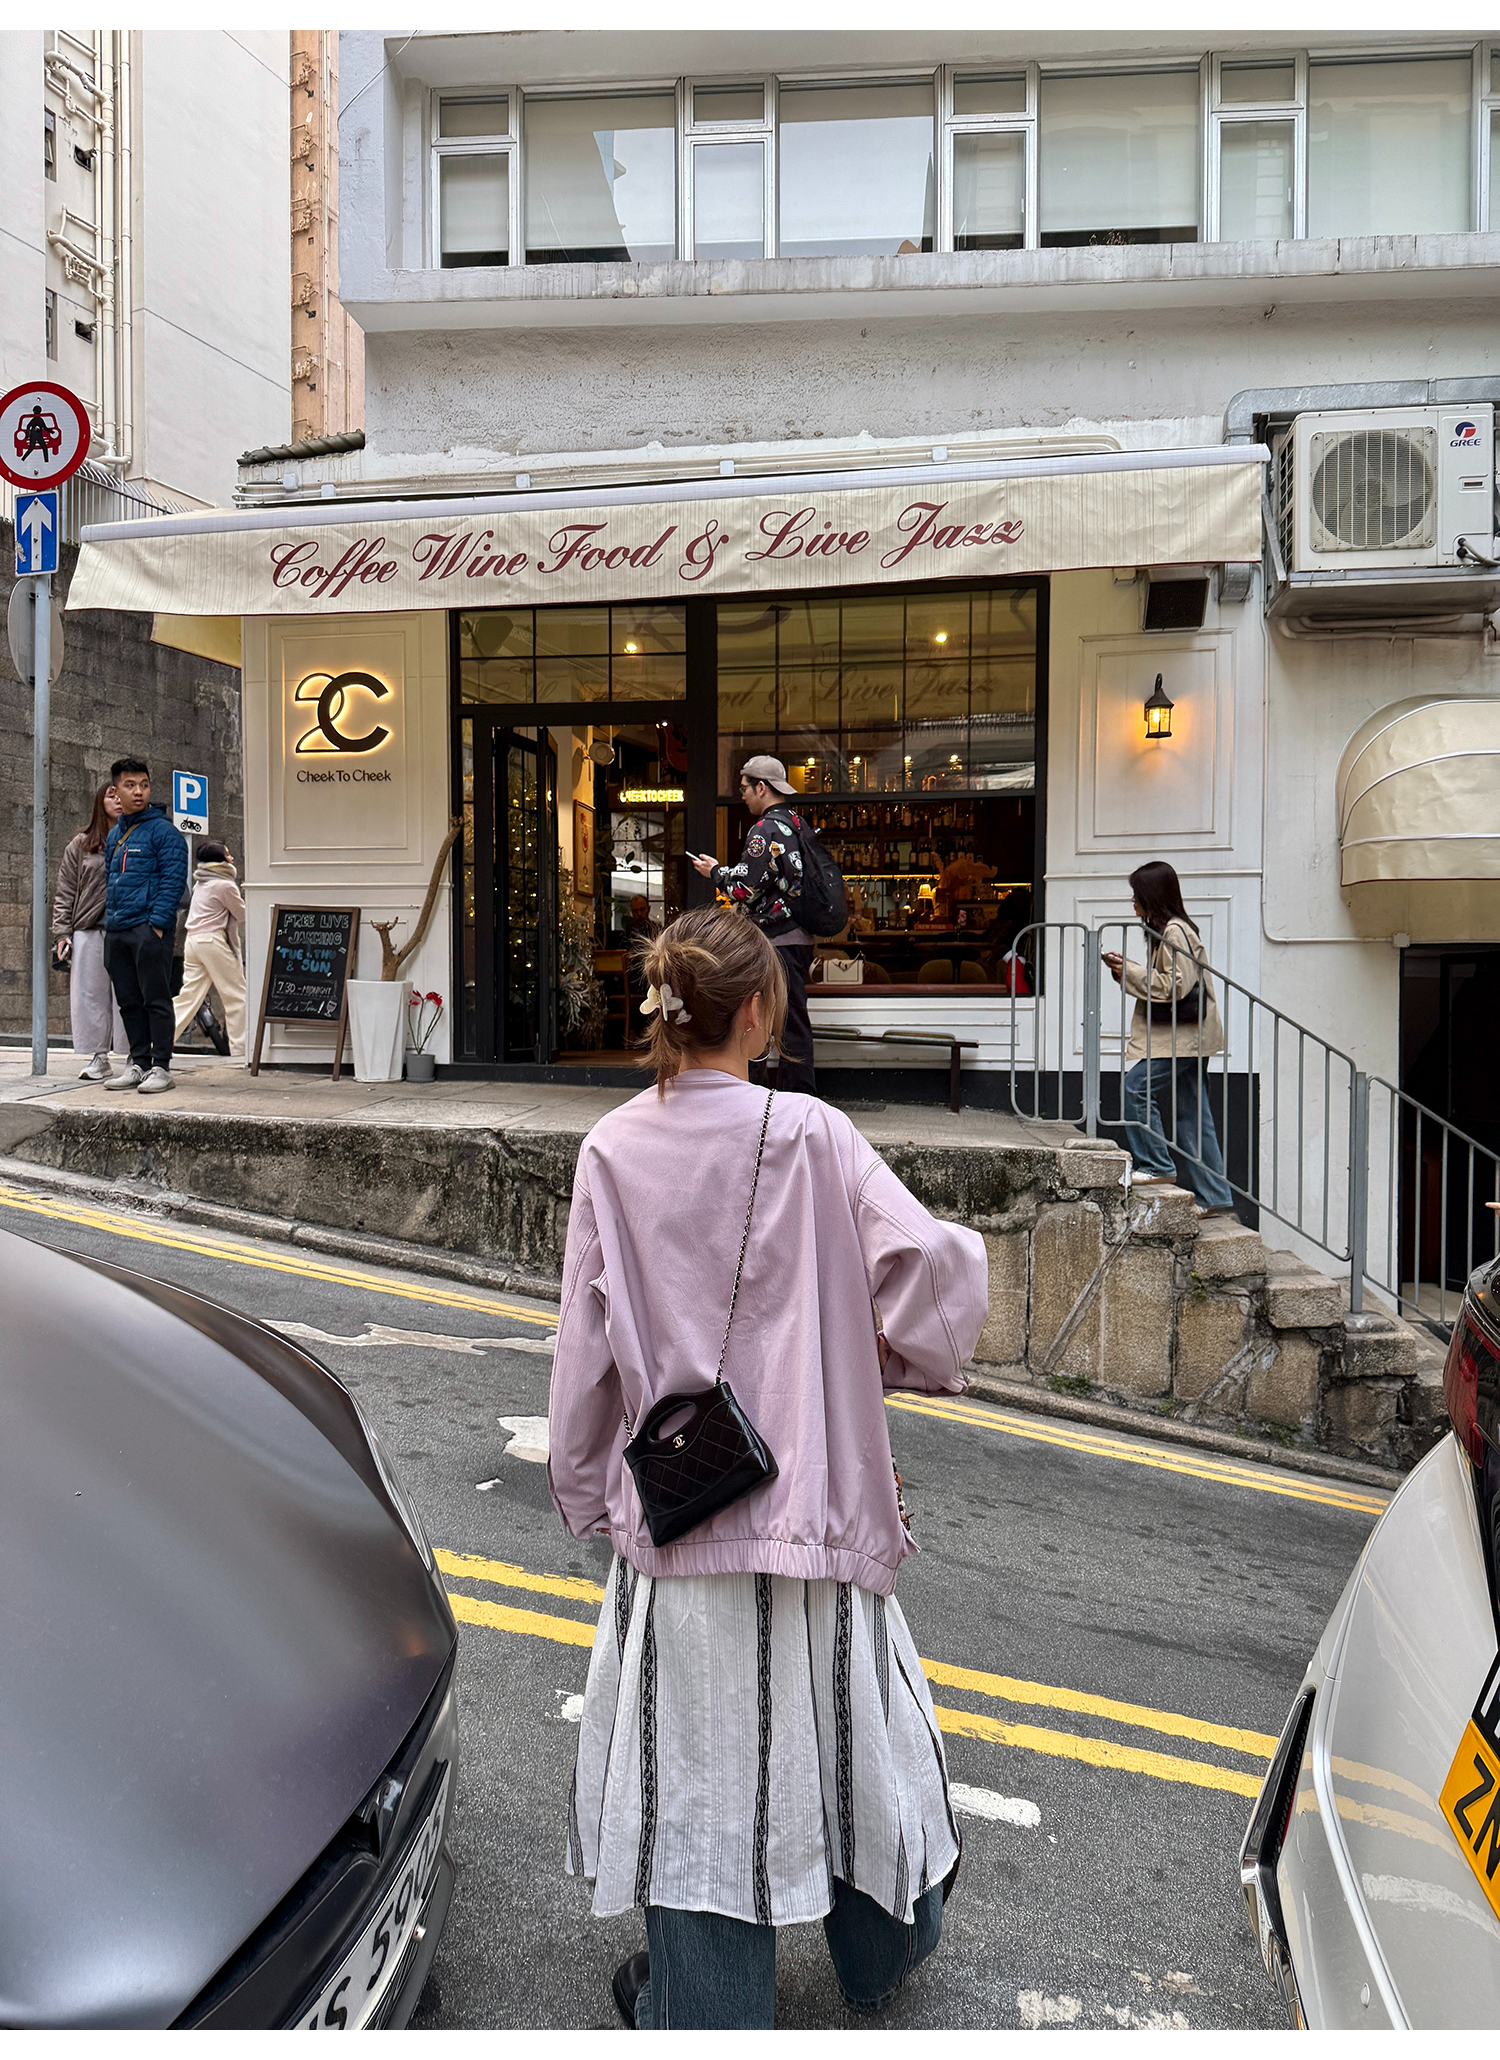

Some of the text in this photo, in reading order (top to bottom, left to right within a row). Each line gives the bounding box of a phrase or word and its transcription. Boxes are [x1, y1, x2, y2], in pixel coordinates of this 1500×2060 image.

[1450, 439, 1481, 447] GREE
[270, 501, 1024, 598] Coffee Wine Food & Live Jazz
[297, 769, 391, 782] Cheek To Cheek
[180, 776, 202, 811] P
[284, 914, 349, 929] FREE LIVE
[288, 930, 343, 946] JAMMING
[286, 959, 331, 974] & SUN
[308, 1975, 352, 2030] S
